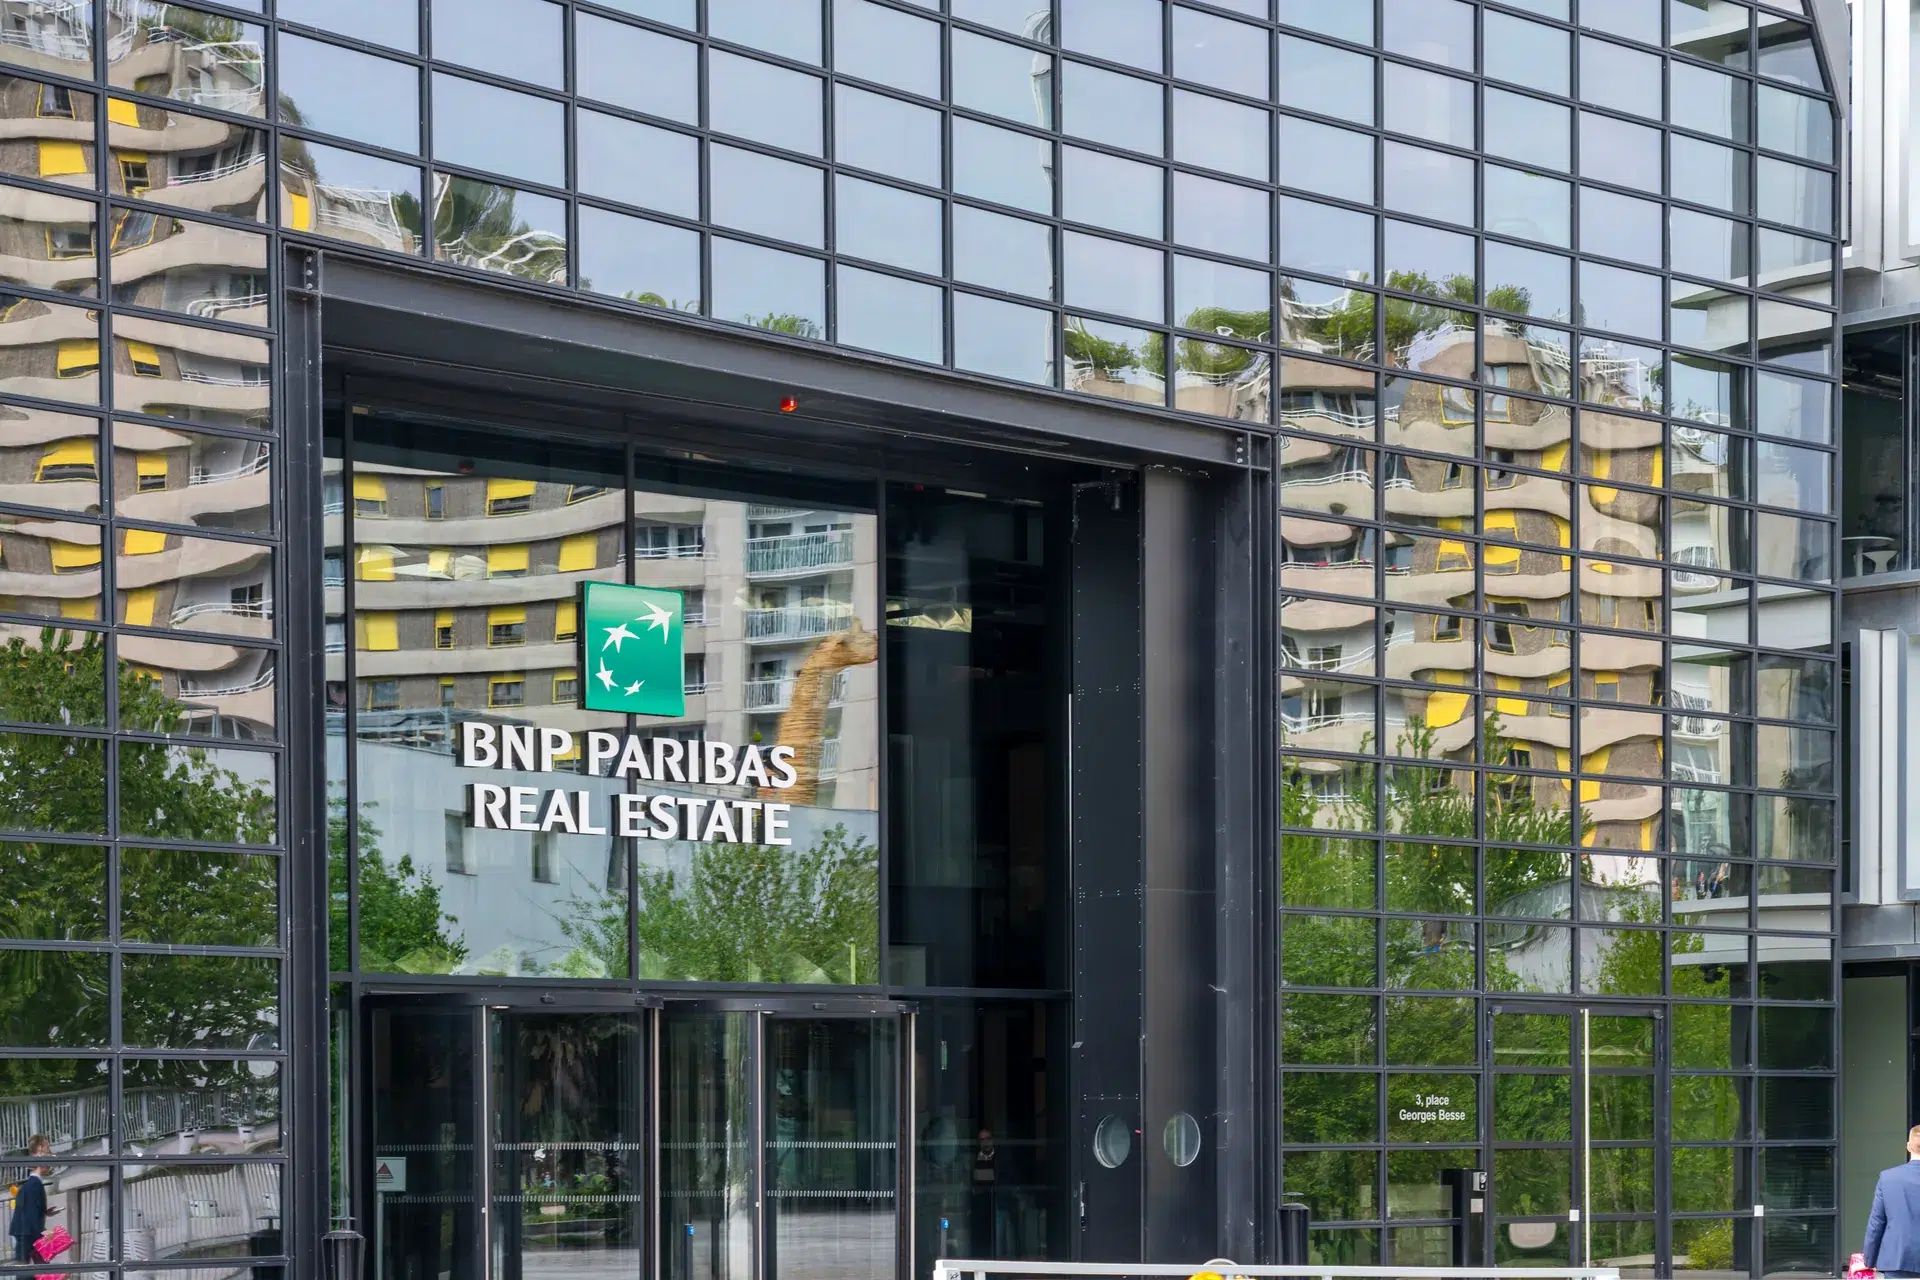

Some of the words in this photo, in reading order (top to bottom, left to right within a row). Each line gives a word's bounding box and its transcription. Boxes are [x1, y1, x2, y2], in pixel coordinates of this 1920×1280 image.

[462, 721, 573, 772] BNP
[586, 731, 797, 789] PARIBAS
[473, 783, 606, 836] REAL
[618, 793, 792, 846] ESTATE
[1399, 1109, 1436, 1123] Georges
[1438, 1109, 1465, 1120] Besse
[1415, 1093, 1424, 1107] 3,
[1426, 1094, 1449, 1107] place
